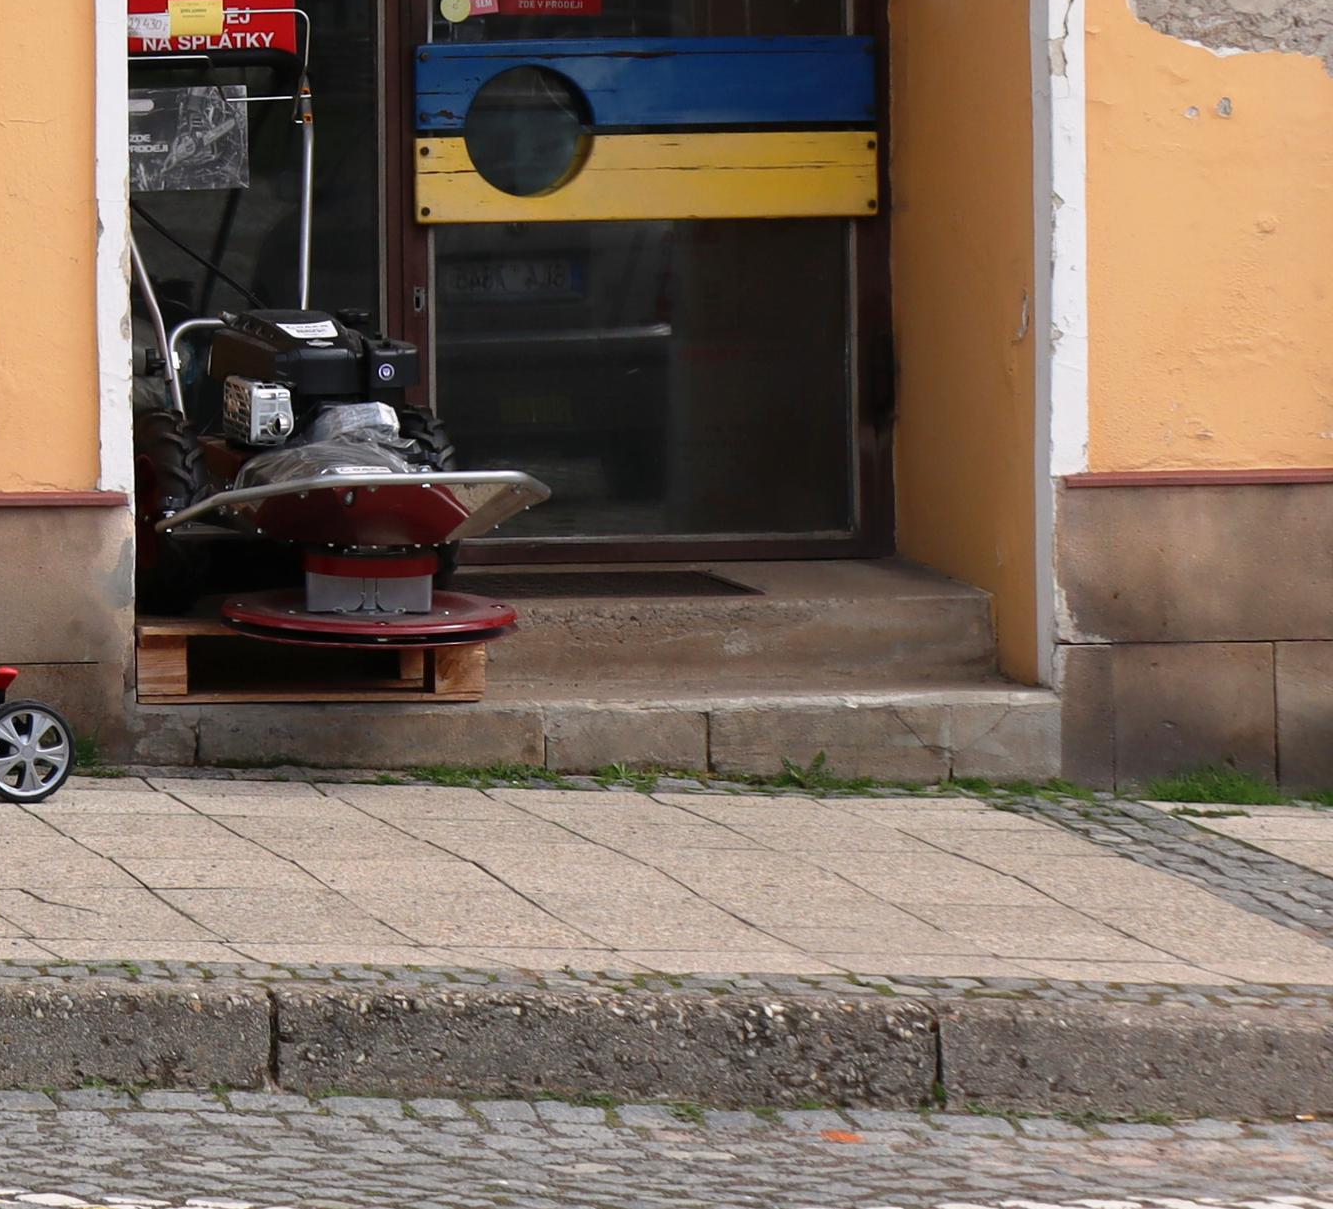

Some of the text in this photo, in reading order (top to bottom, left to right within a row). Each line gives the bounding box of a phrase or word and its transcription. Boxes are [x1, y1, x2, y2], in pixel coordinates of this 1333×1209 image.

[518, 0, 535, 9] ZDE
[545, 0, 584, 9] PRODEJI
[129, 143, 169, 153] RODEJI
